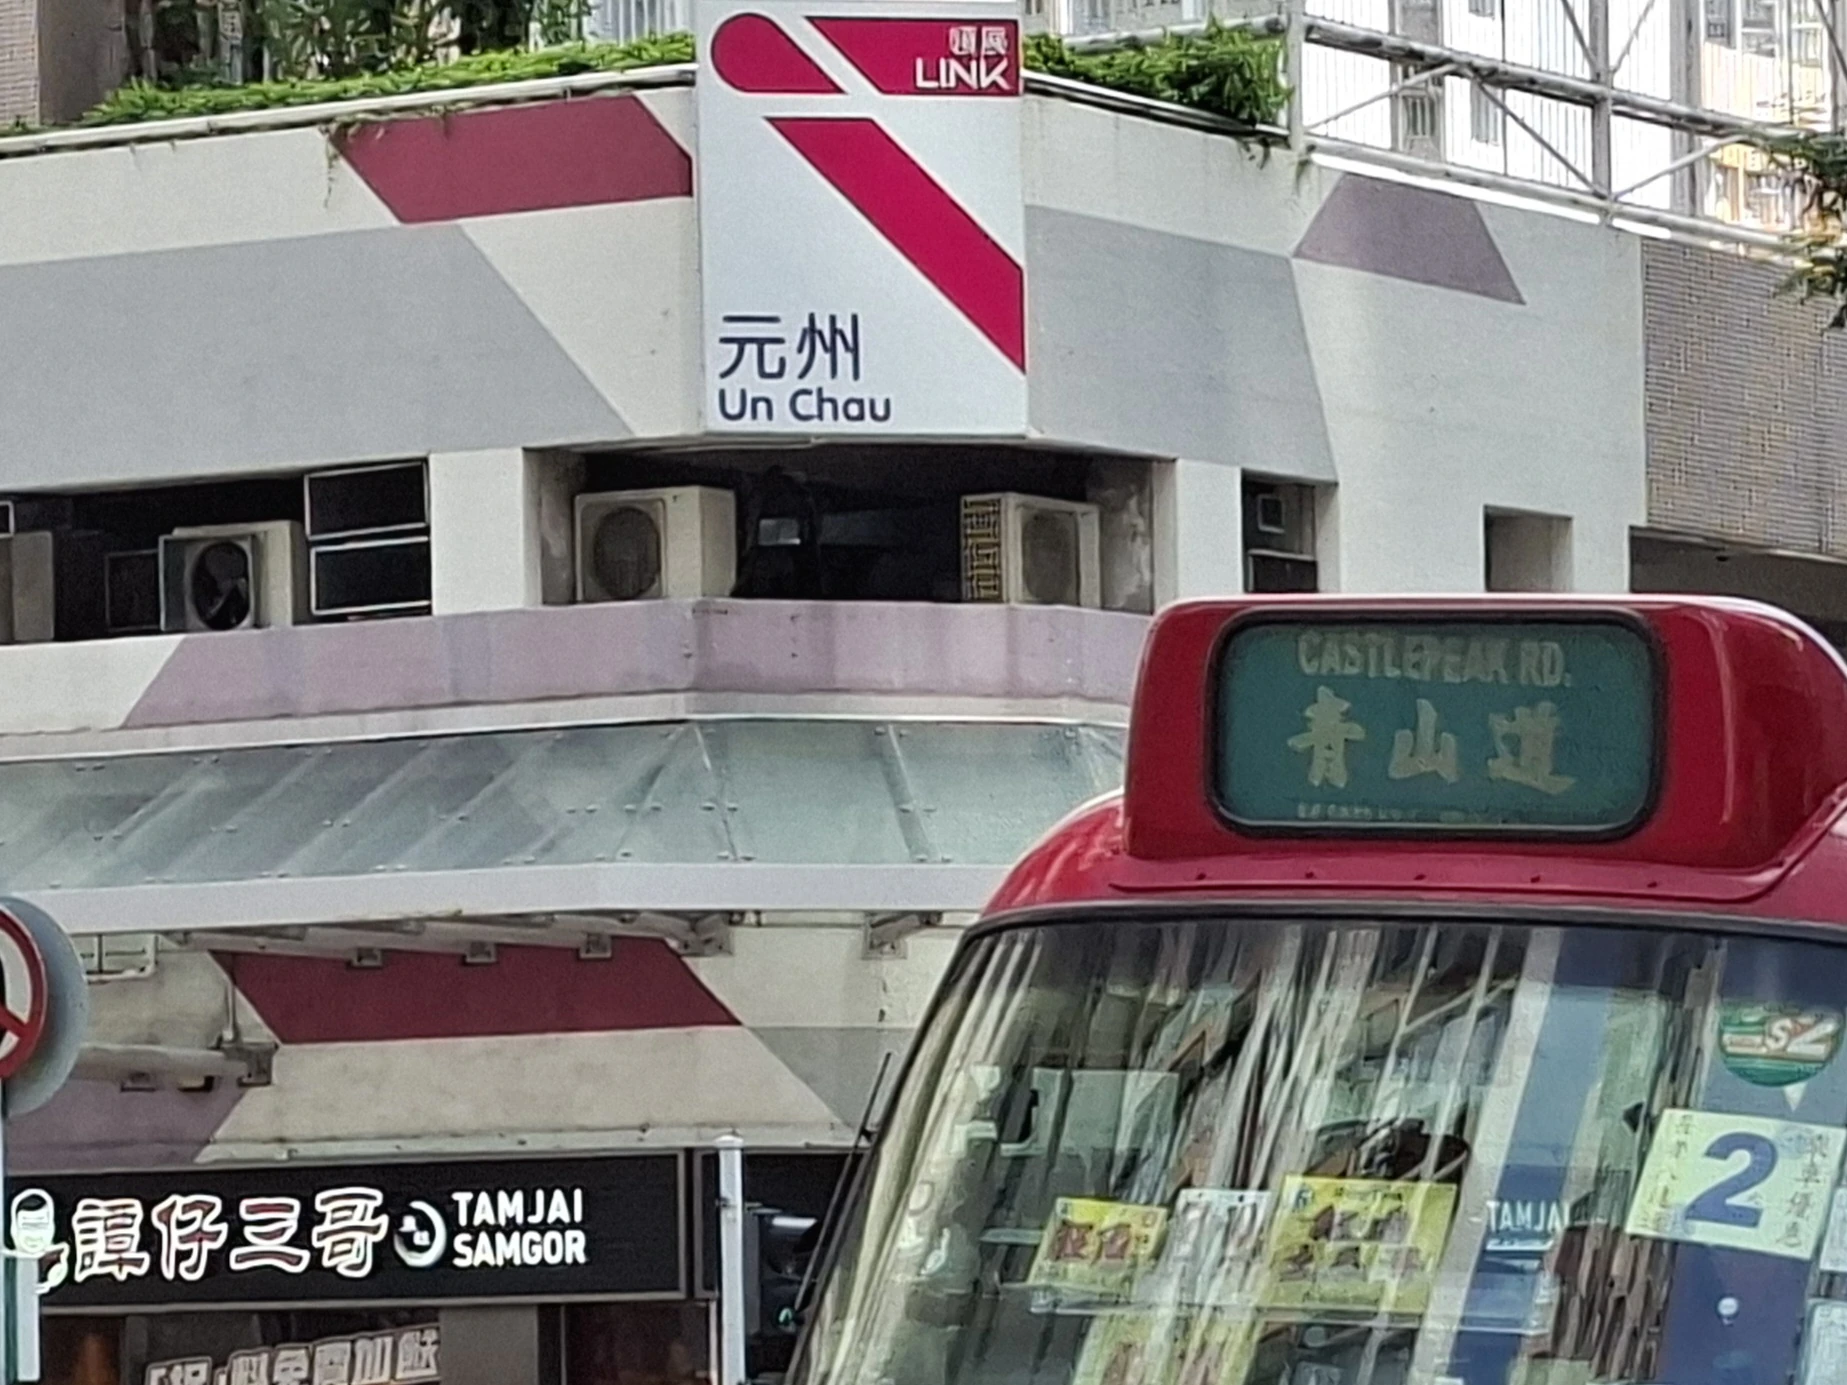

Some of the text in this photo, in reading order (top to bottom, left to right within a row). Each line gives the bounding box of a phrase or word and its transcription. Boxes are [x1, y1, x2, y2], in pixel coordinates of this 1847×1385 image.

[914, 57, 1011, 90] LINK
[718, 312, 860, 381] 元州
[718, 388, 892, 423] Un Chau
[1519, 641, 1572, 687] RD.
[1287, 685, 1578, 795] 青山道
[1685, 1132, 1778, 1229] 2
[452, 1188, 583, 1224] TAMJAI
[73, 1186, 390, 1281] 譚仔三哥
[452, 1229, 587, 1267] SAMGOR
